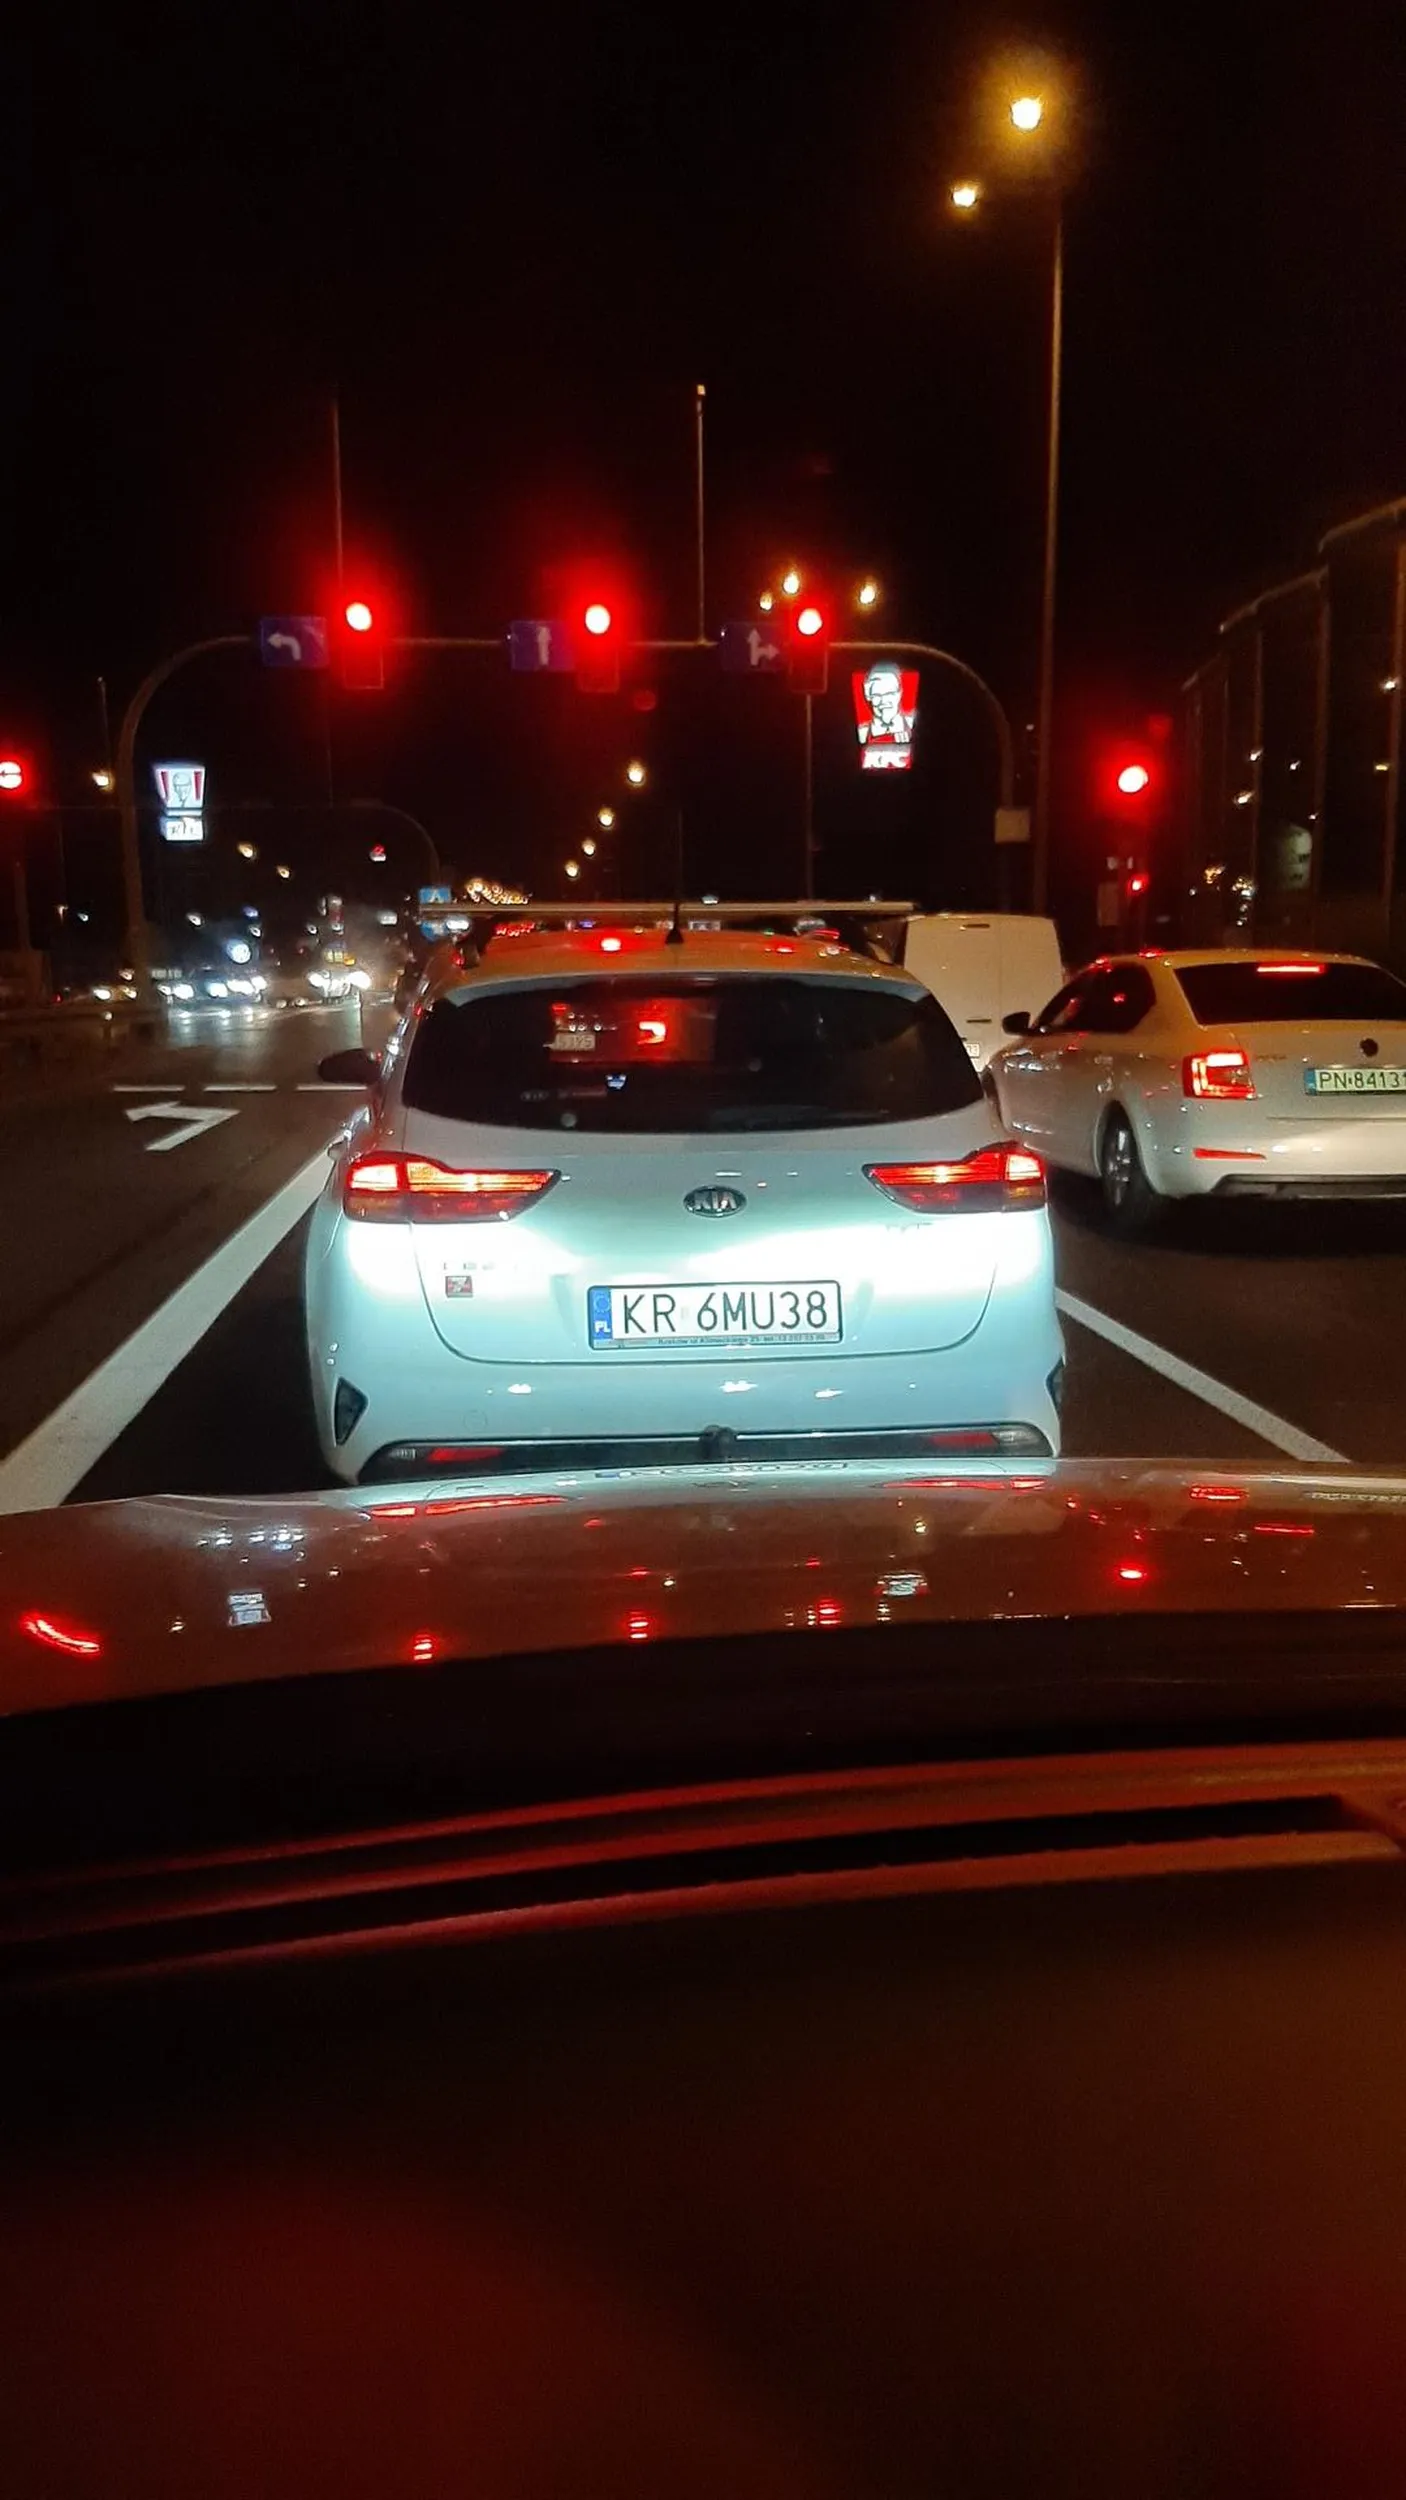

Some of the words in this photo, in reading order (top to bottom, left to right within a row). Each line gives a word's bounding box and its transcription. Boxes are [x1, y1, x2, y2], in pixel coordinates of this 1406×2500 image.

[694, 1190, 737, 1209] KIA
[624, 1294, 676, 1334] KR
[697, 1290, 828, 1332] 6MU38
[595, 1321, 610, 1333] PL
